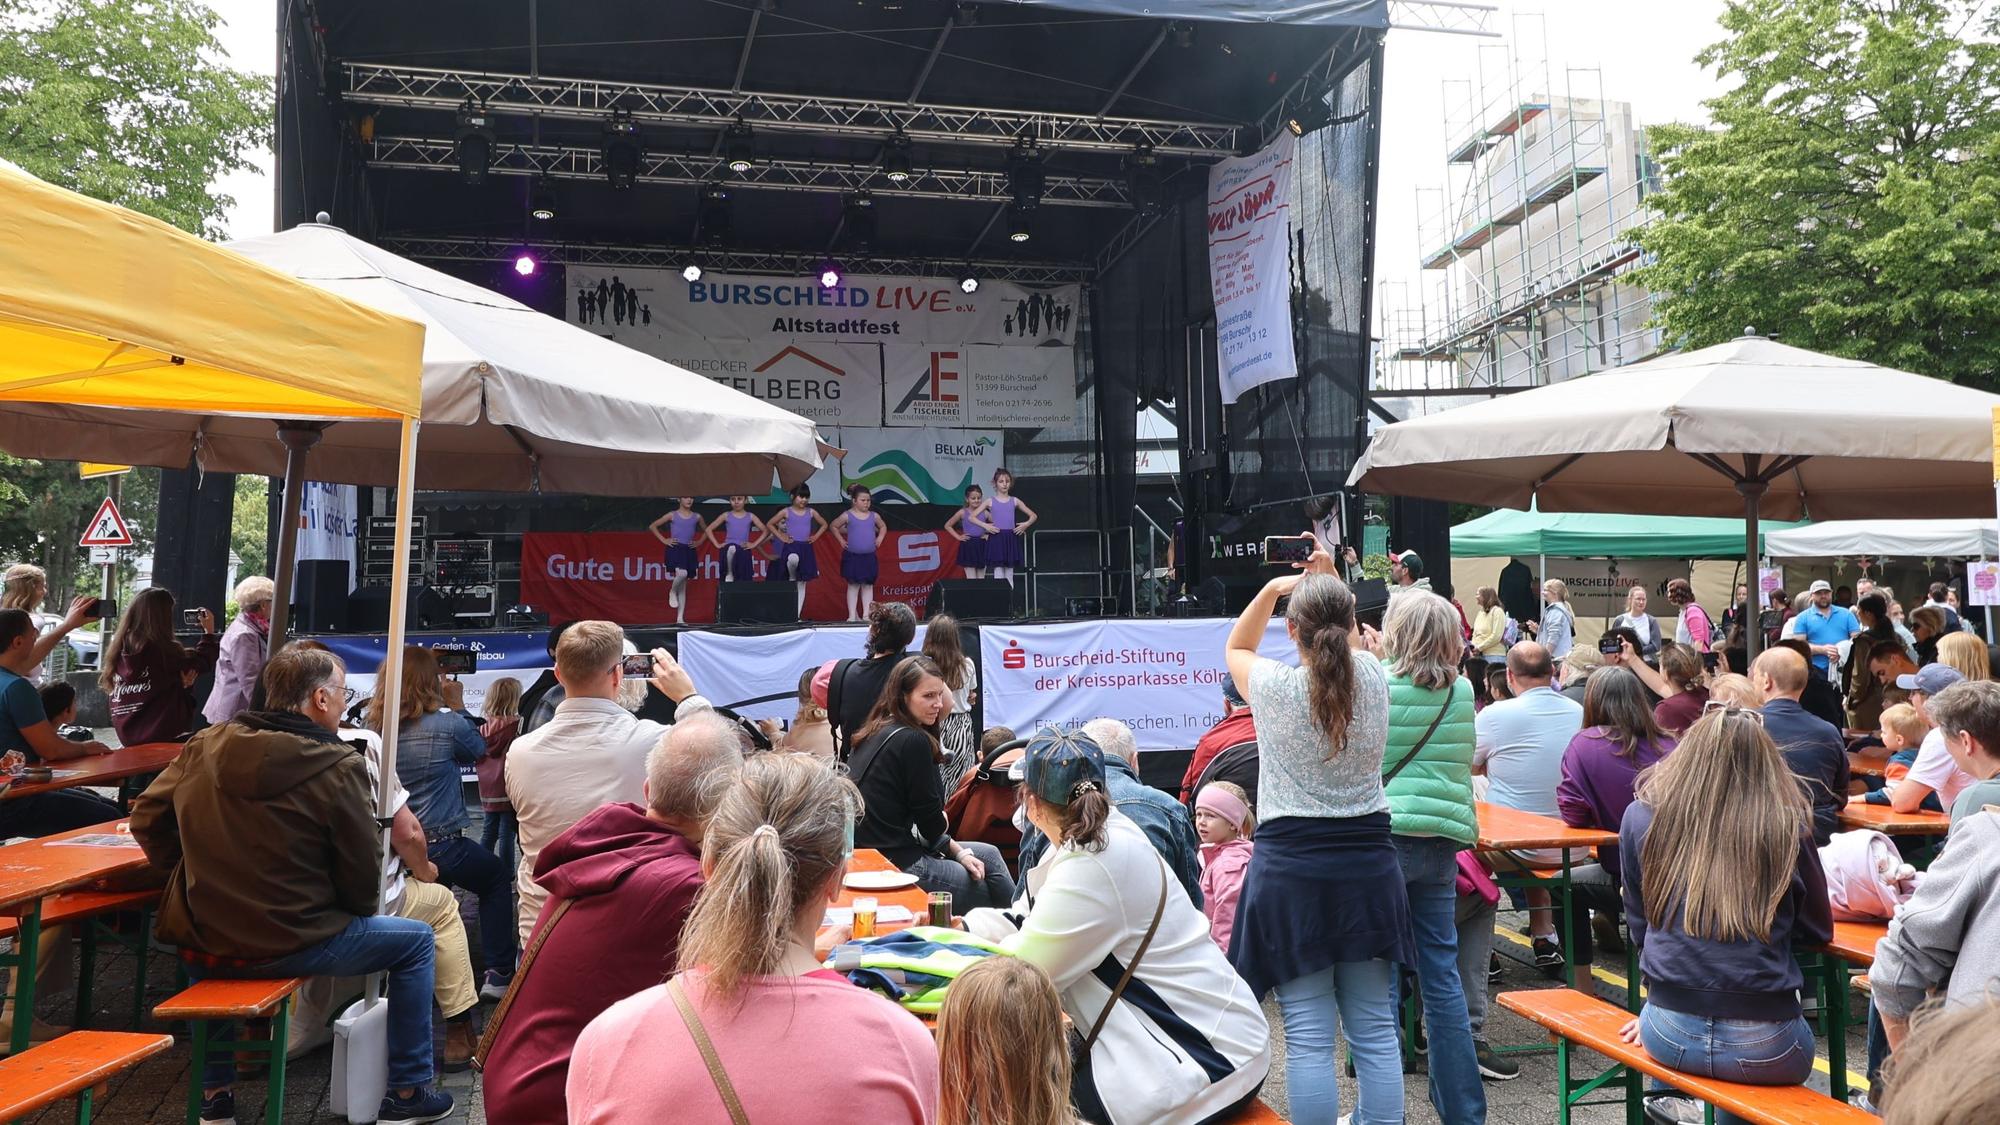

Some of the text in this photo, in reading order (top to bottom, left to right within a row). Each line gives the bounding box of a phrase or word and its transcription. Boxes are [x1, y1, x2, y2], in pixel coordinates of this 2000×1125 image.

[689, 282, 976, 312] BURSCHEID LIVE e.V.
[772, 317, 900, 335] Altstadtfest
[975, 373, 1049, 382] Pastor-Löh-Straße 6
[713, 376, 841, 400] TELBERG
[1000, 383, 1037, 391] Burscheid
[976, 399, 1004, 407] Telefon
[913, 408, 960, 416] TISCHLEREI
[976, 414, 1071, 423] info@tischlerei-engeln.de
[935, 443, 984, 456] BELKAW
[547, 553, 614, 581] Gute
[882, 583, 934, 596] Kreisspar
[910, 597, 926, 607] Köl
[1033, 648, 1186, 667] Burscheid-Stiftung
[1034, 675, 1062, 691] der
[1067, 670, 1188, 690] Kreissparkasse
[1183, 713, 1197, 728] In
